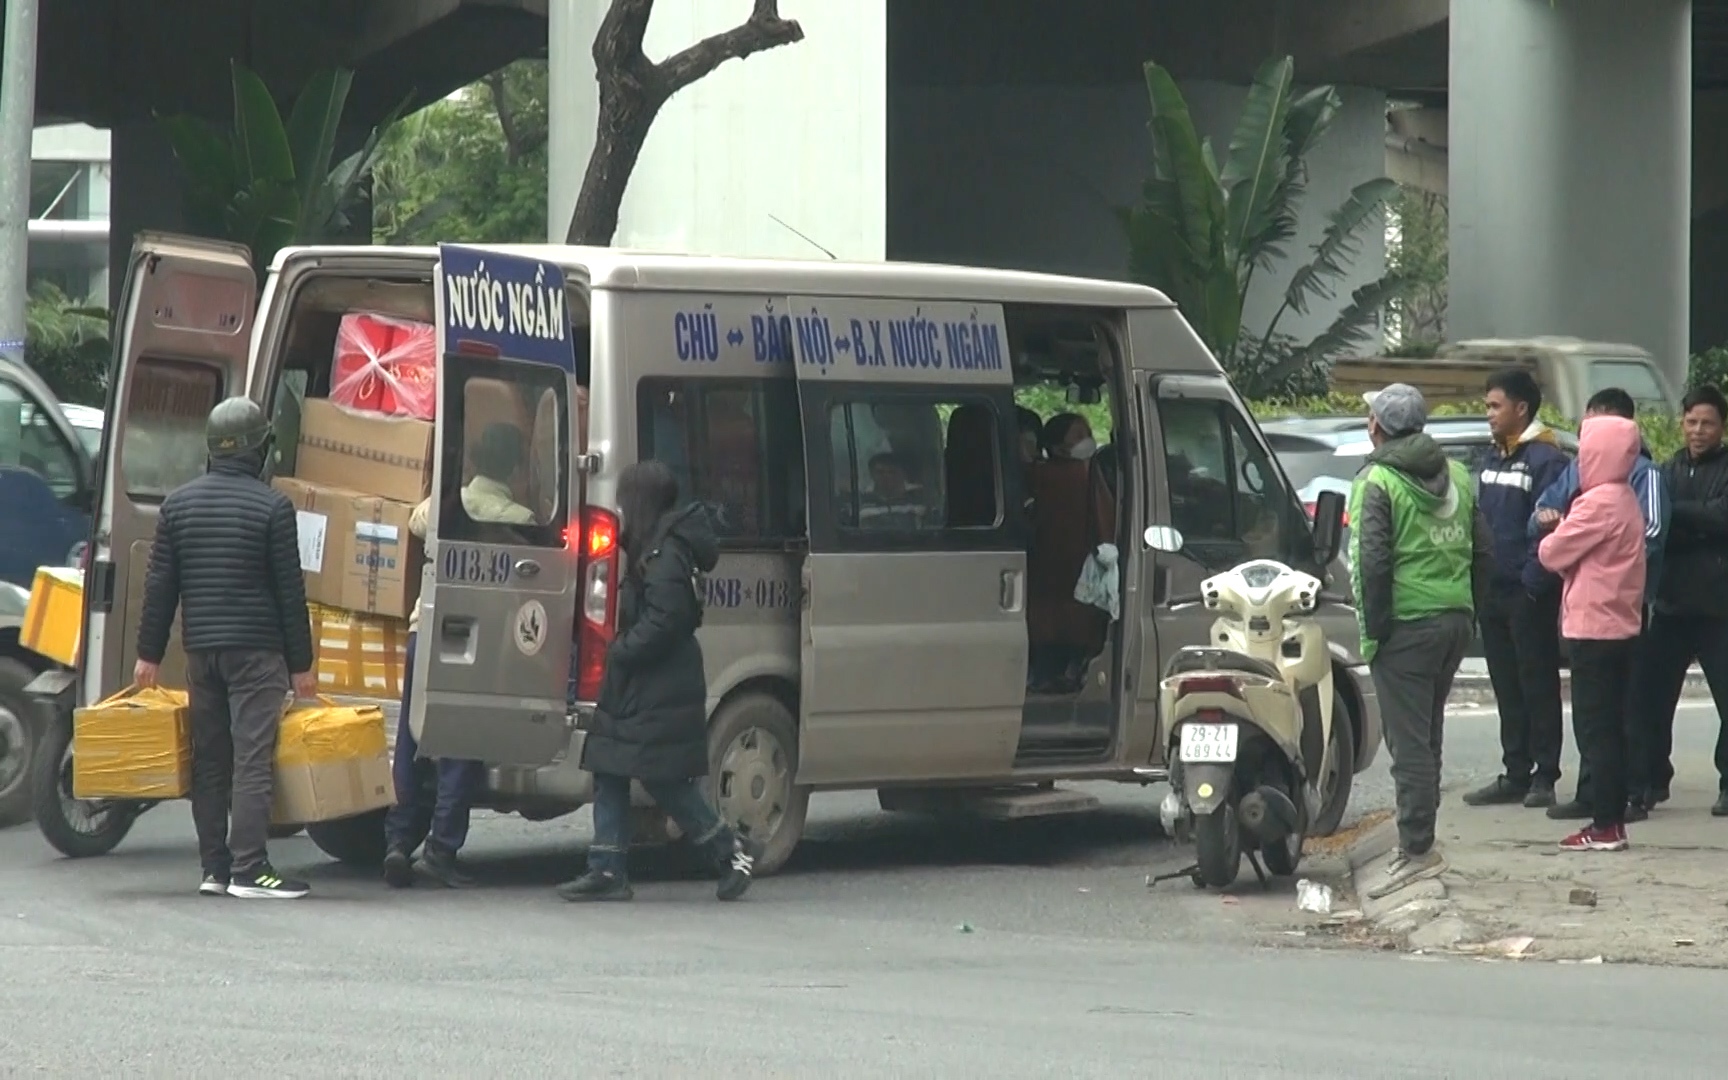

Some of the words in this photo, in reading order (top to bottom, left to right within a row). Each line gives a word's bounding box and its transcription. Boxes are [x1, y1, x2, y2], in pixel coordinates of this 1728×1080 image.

[447, 260, 504, 333] NƯỚC
[507, 263, 564, 341] NGẦM
[674, 302, 719, 362] CHŨ
[795, 306, 835, 376] NỘI
[850, 318, 886, 367] B.X
[888, 306, 943, 369] NƯỚC
[445, 546, 511, 583] 013.49
